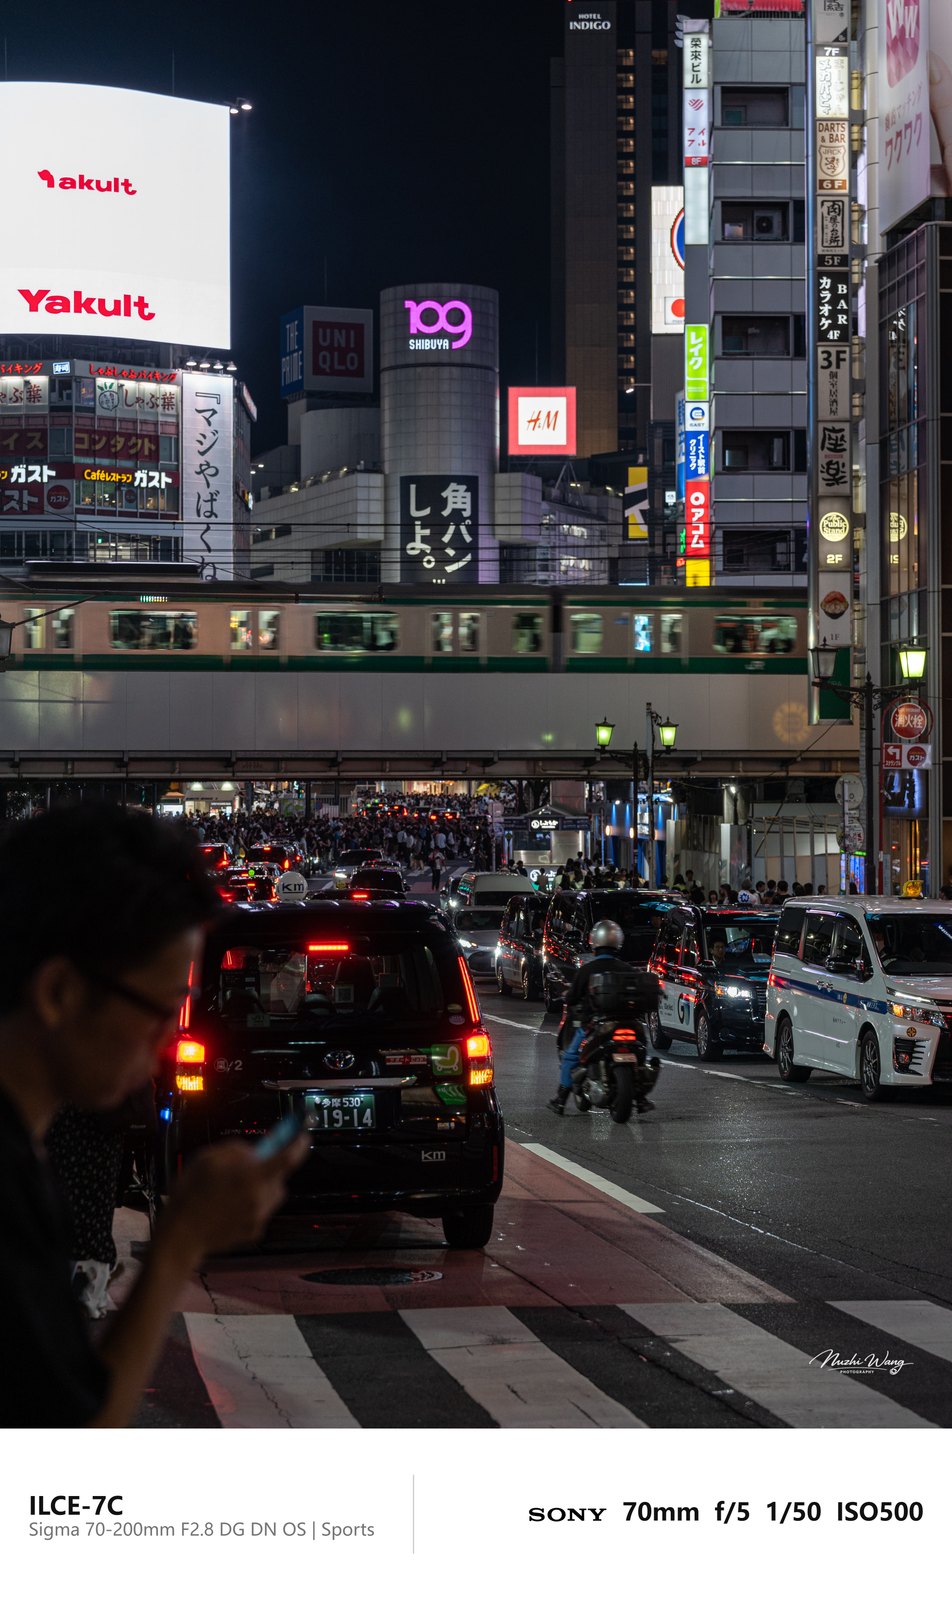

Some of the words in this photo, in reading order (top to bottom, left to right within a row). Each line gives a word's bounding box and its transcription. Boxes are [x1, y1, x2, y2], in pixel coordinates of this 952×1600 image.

[569, 21, 611, 30] INDIGO
[823, 47, 840, 57] 7F
[818, 123, 846, 132] DARTS
[820, 135, 826, 143] &
[829, 133, 846, 143] BAR
[824, 256, 841, 265] 5F
[17, 289, 156, 321] Yakult
[819, 276, 832, 330] カラオケ
[837, 284, 848, 325] BAR
[404, 300, 473, 349] 109
[286, 320, 298, 352] THE
[319, 328, 355, 348] UNI
[409, 339, 449, 350] SHIBUYA
[827, 330, 841, 340] 4F
[689, 331, 703, 370] レイク
[820, 350, 847, 369] 3F
[281, 350, 303, 387] PRIME
[319, 351, 358, 373] QLO
[89, 363, 177, 383] しゃぶしゃぶバイキング
[124, 389, 175, 413] しゃぶ葉
[527, 410, 559, 431] H&M
[75, 433, 156, 456] コンタクト
[10, 464, 57, 483] ガスト
[84, 469, 133, 483] Caféレストラン
[134, 470, 173, 489] ガスト
[50, 495, 69, 503] ガスト
[690, 508, 705, 548] アコム
[823, 519, 847, 528] Public
[826, 554, 843, 564] 2F
[894, 714, 926, 729] 消火栓
[342, 1097, 361, 1108] 530
[323, 1108, 373, 1128] 19-14
